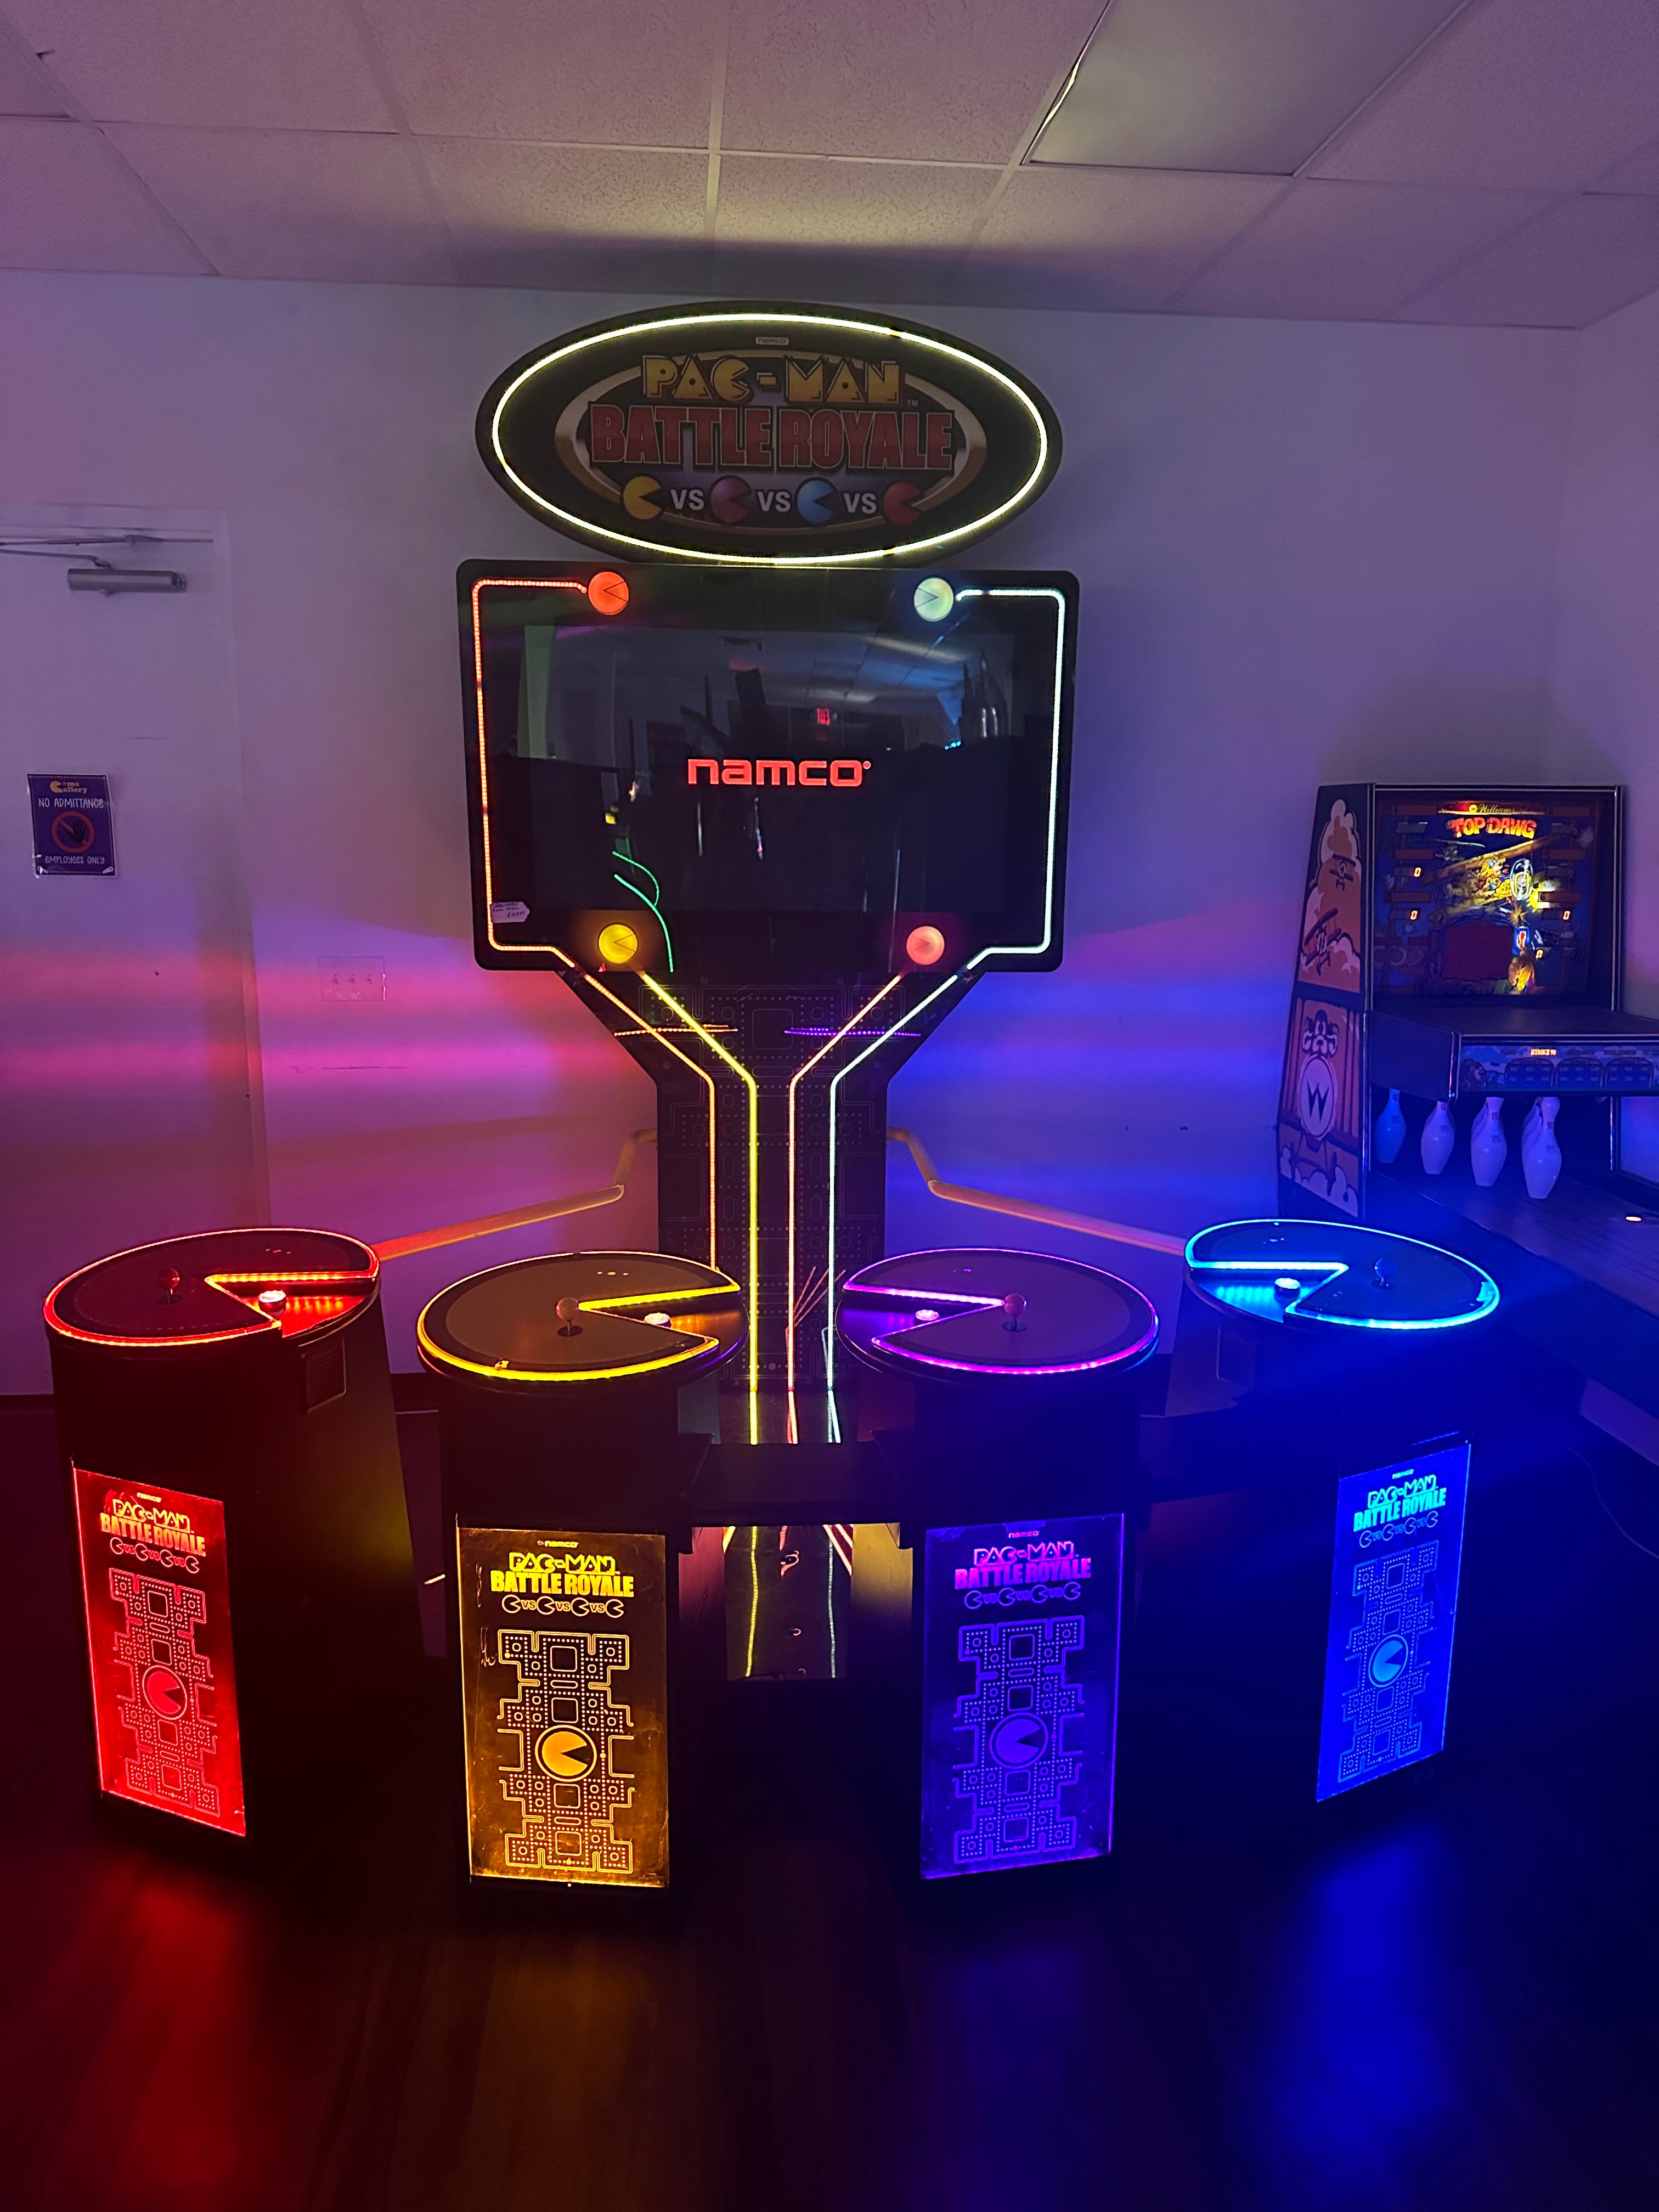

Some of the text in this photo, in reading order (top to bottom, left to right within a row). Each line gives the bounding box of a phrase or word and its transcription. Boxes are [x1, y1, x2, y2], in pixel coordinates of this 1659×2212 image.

[642, 354, 904, 405] PAC-MAN
[590, 404, 954, 472] BATTLE ROYALE
[670, 489, 878, 515] VS VS VS
[39, 798, 49, 808] NO
[1447, 817, 1537, 839] TOP DAWG
[1367, 1474, 1436, 1509] PAC-MAN
[112, 1498, 190, 1533] PAC-MAN
[1353, 1487, 1447, 1532] BATTLE ROYALE
[100, 1512, 206, 1556] BATTLE ROYALE
[1008, 1530, 1040, 1538] namco
[123, 1544, 185, 1567] VS VS VS
[509, 1552, 616, 1576] PAC-MAN
[974, 1541, 1074, 1566] PAC-MAN
[490, 1570, 634, 1598] BATTLE ROYALE
[955, 1558, 1092, 1589] BATTLE ROYALE
[521, 1600, 605, 1613] VS VS VS
